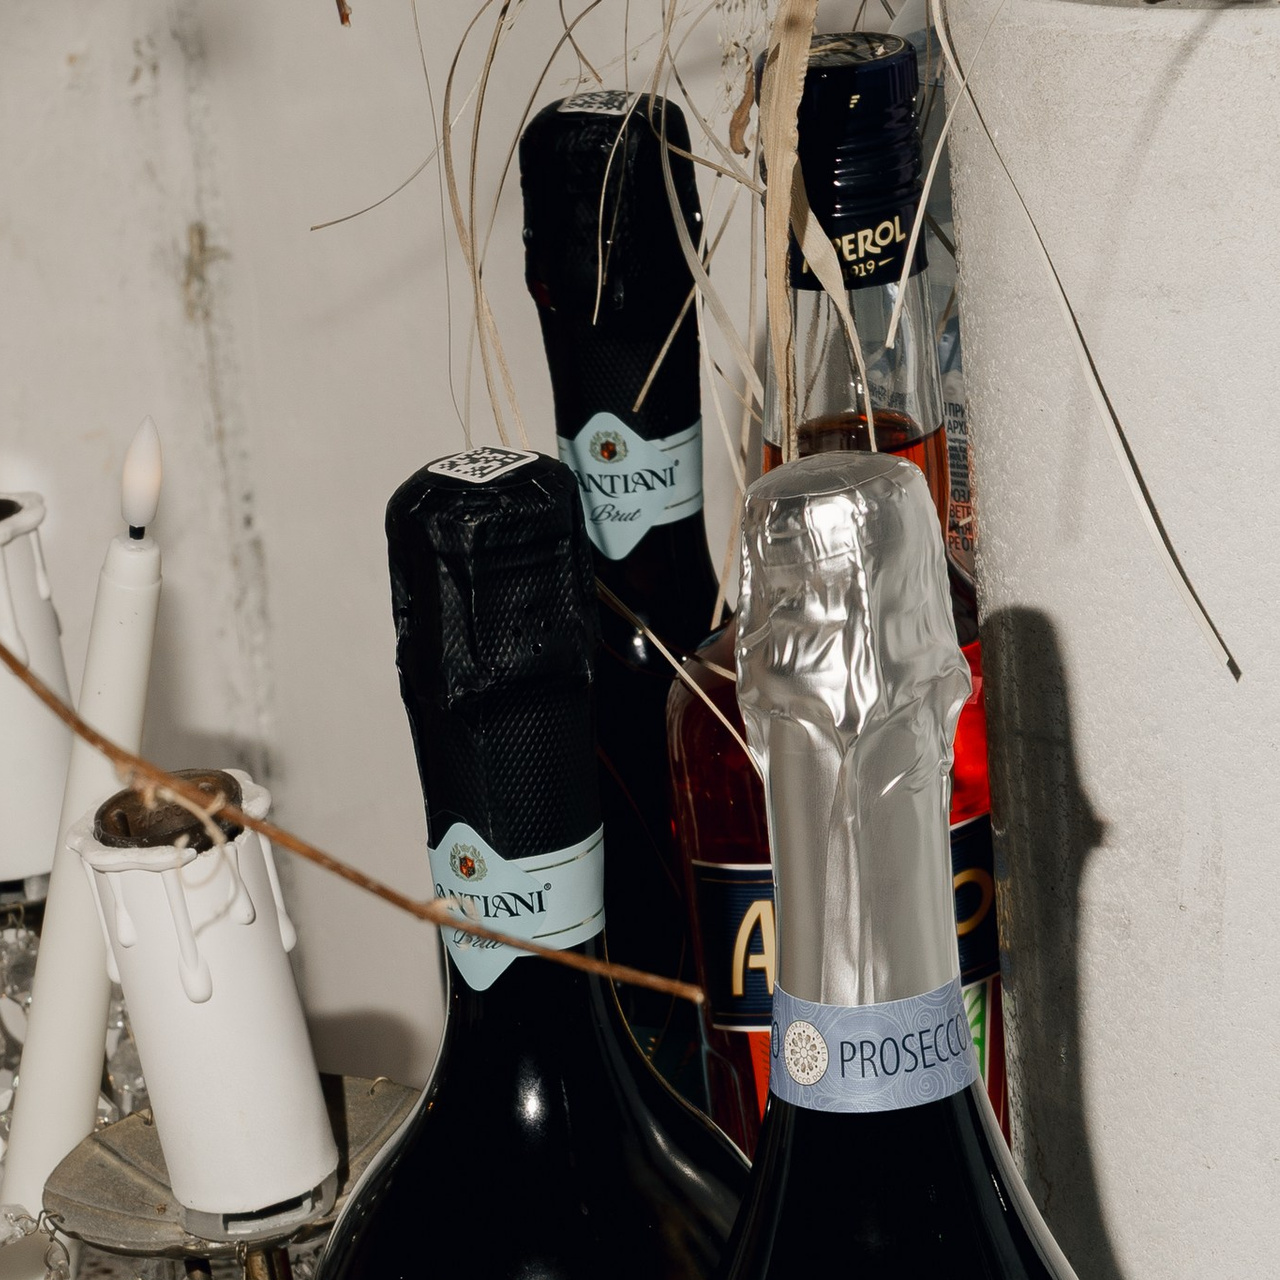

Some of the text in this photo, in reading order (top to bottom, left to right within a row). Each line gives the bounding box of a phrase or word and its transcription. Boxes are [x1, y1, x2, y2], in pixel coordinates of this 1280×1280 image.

[574, 465, 677, 499] ANTIANI
[589, 503, 642, 525] Brut
[435, 882, 547, 922] ANTIANI
[839, 1013, 968, 1079] PROSECCO
